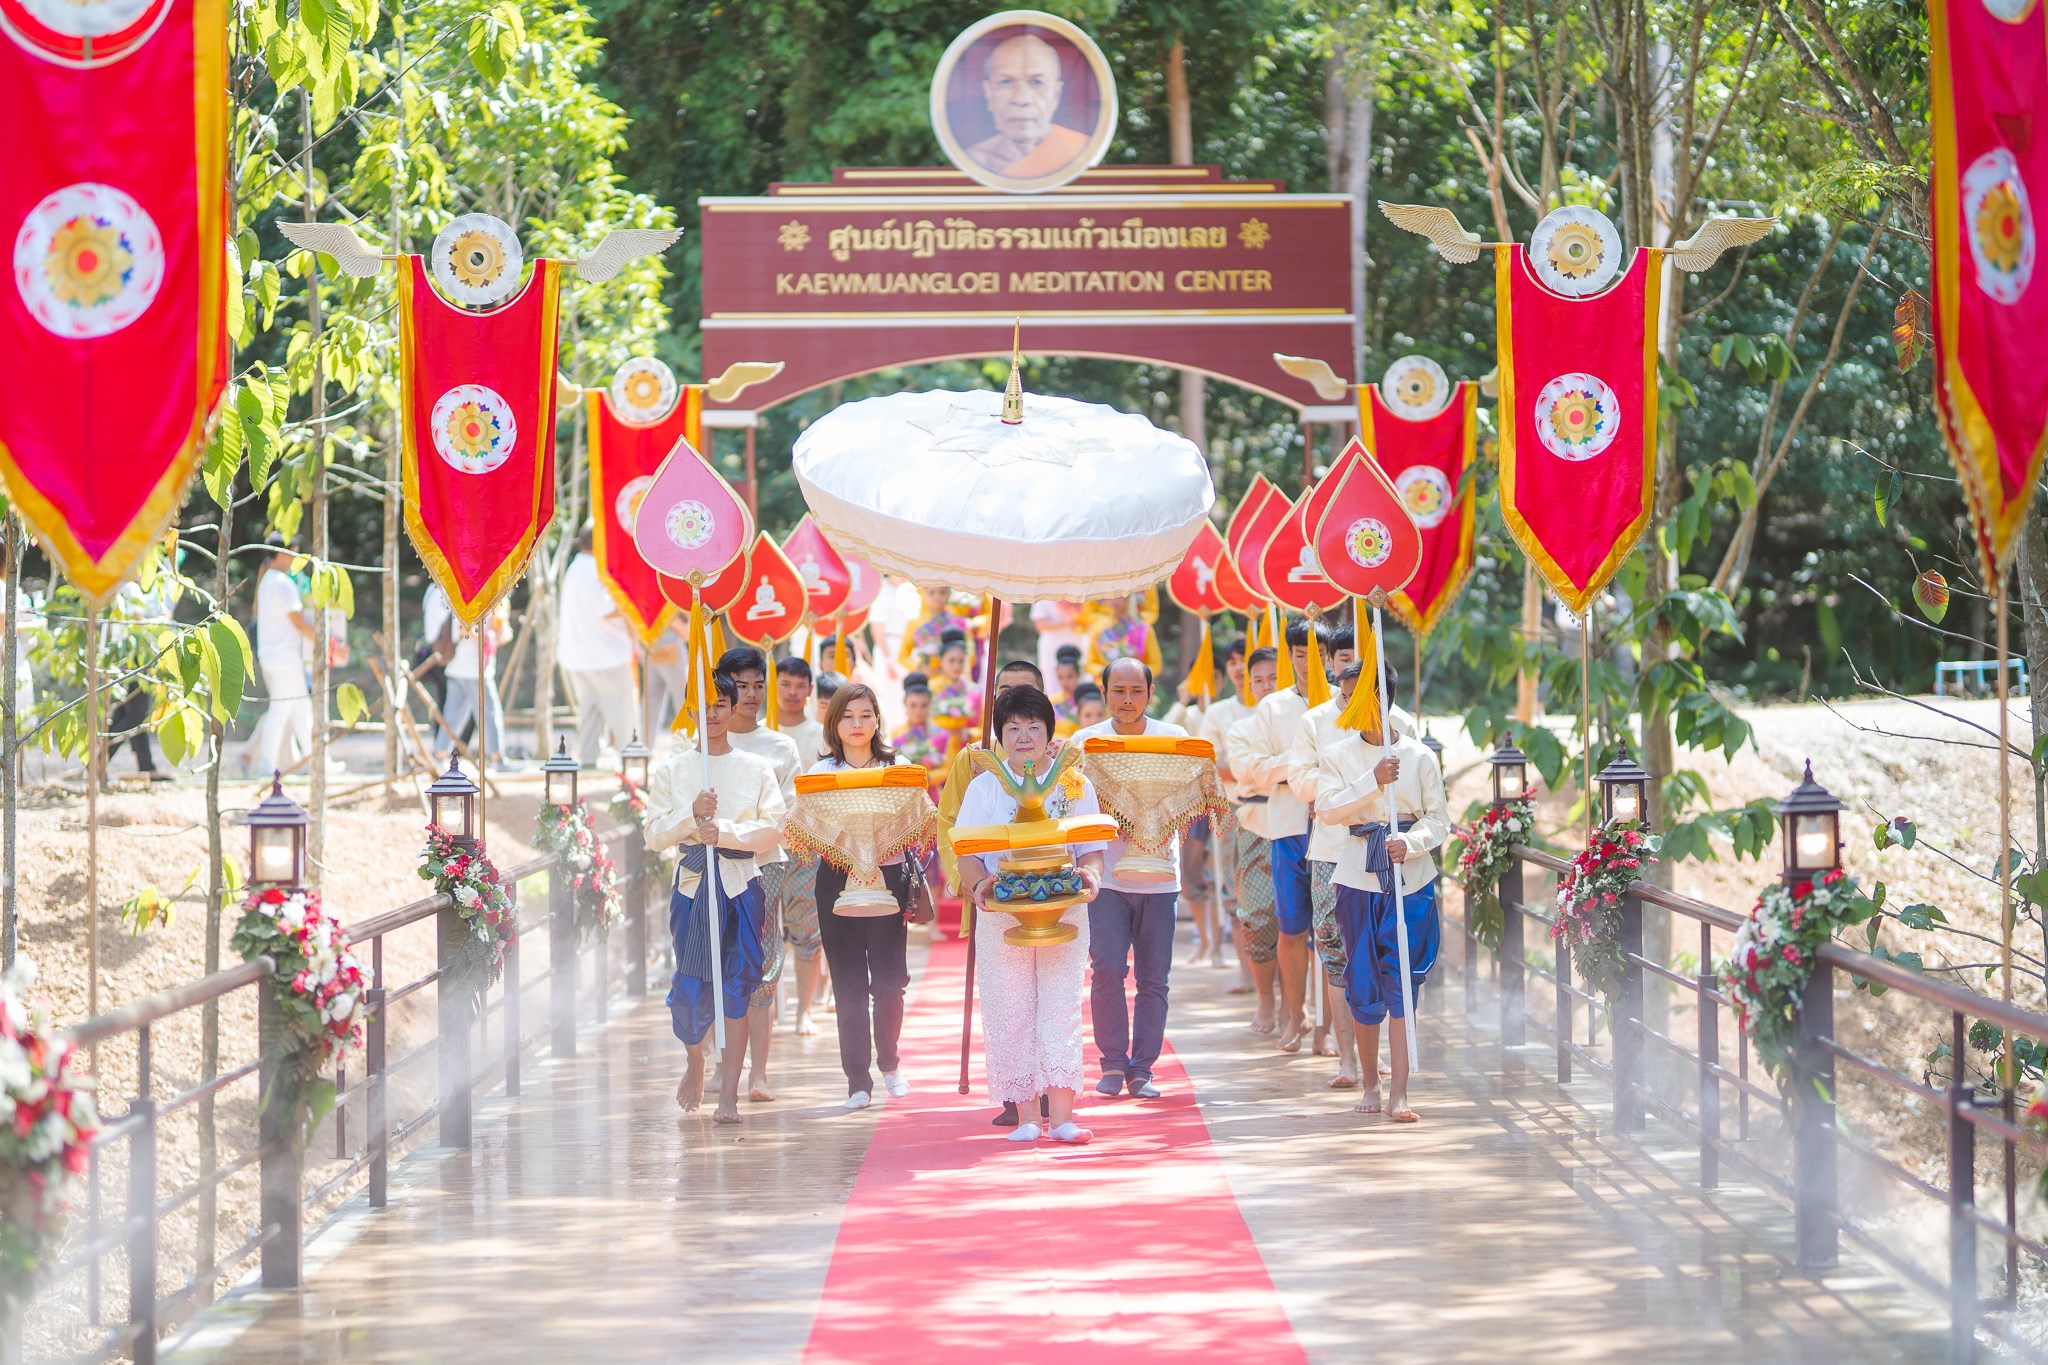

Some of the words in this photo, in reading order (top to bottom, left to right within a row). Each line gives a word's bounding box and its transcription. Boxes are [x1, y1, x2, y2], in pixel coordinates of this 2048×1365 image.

[828, 217, 1228, 262] ศูนย์ปฏิบัติธรรมแก้วเมืองเลย
[775, 271, 1000, 295] KAEWMUANGLOEI
[1008, 270, 1164, 294] MEDITATION
[1174, 269, 1273, 293] CENTER
